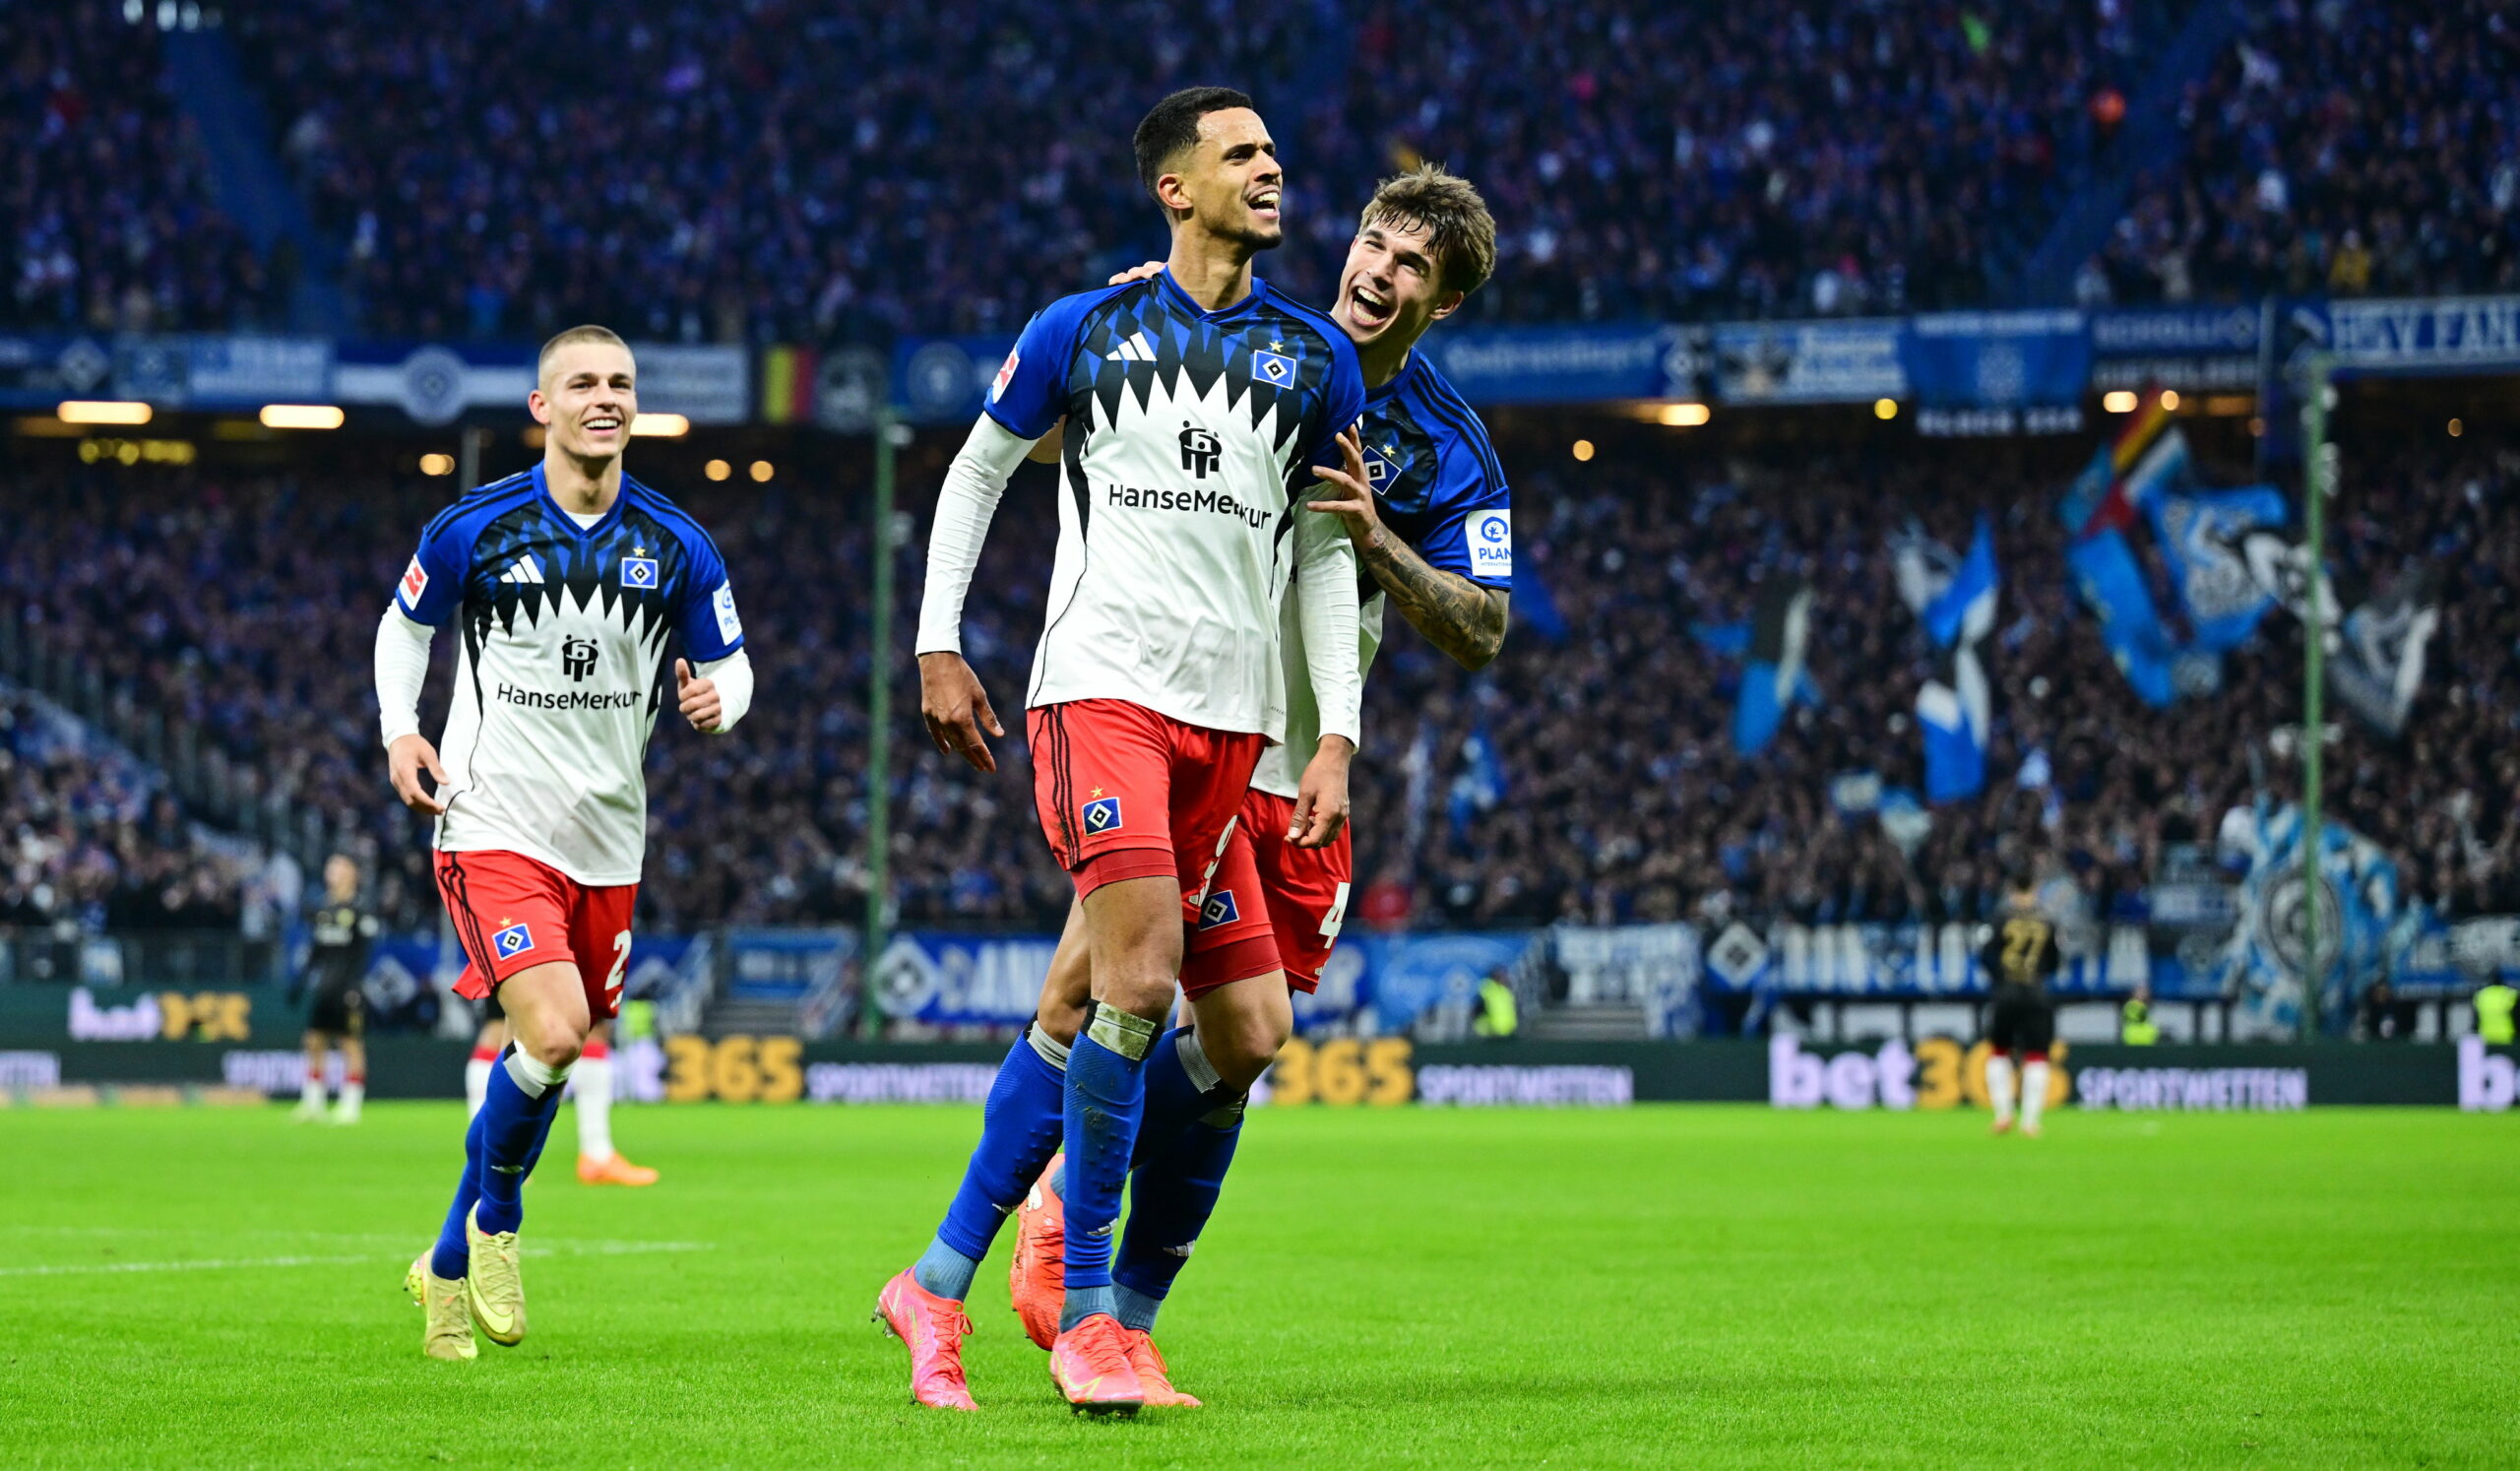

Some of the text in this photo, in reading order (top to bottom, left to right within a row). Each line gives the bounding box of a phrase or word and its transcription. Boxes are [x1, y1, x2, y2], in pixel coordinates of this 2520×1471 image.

[1479, 547, 1512, 560] PLAN
[497, 682, 643, 711] HanseMerkur
[1318, 881, 1351, 949] 4
[2001, 918, 2048, 973] 27
[1417, 1063, 1634, 1106] SPORTWETTEN
[2077, 1065, 2307, 1112] SPORTWETTEN
[2458, 1033, 2520, 1111] b
